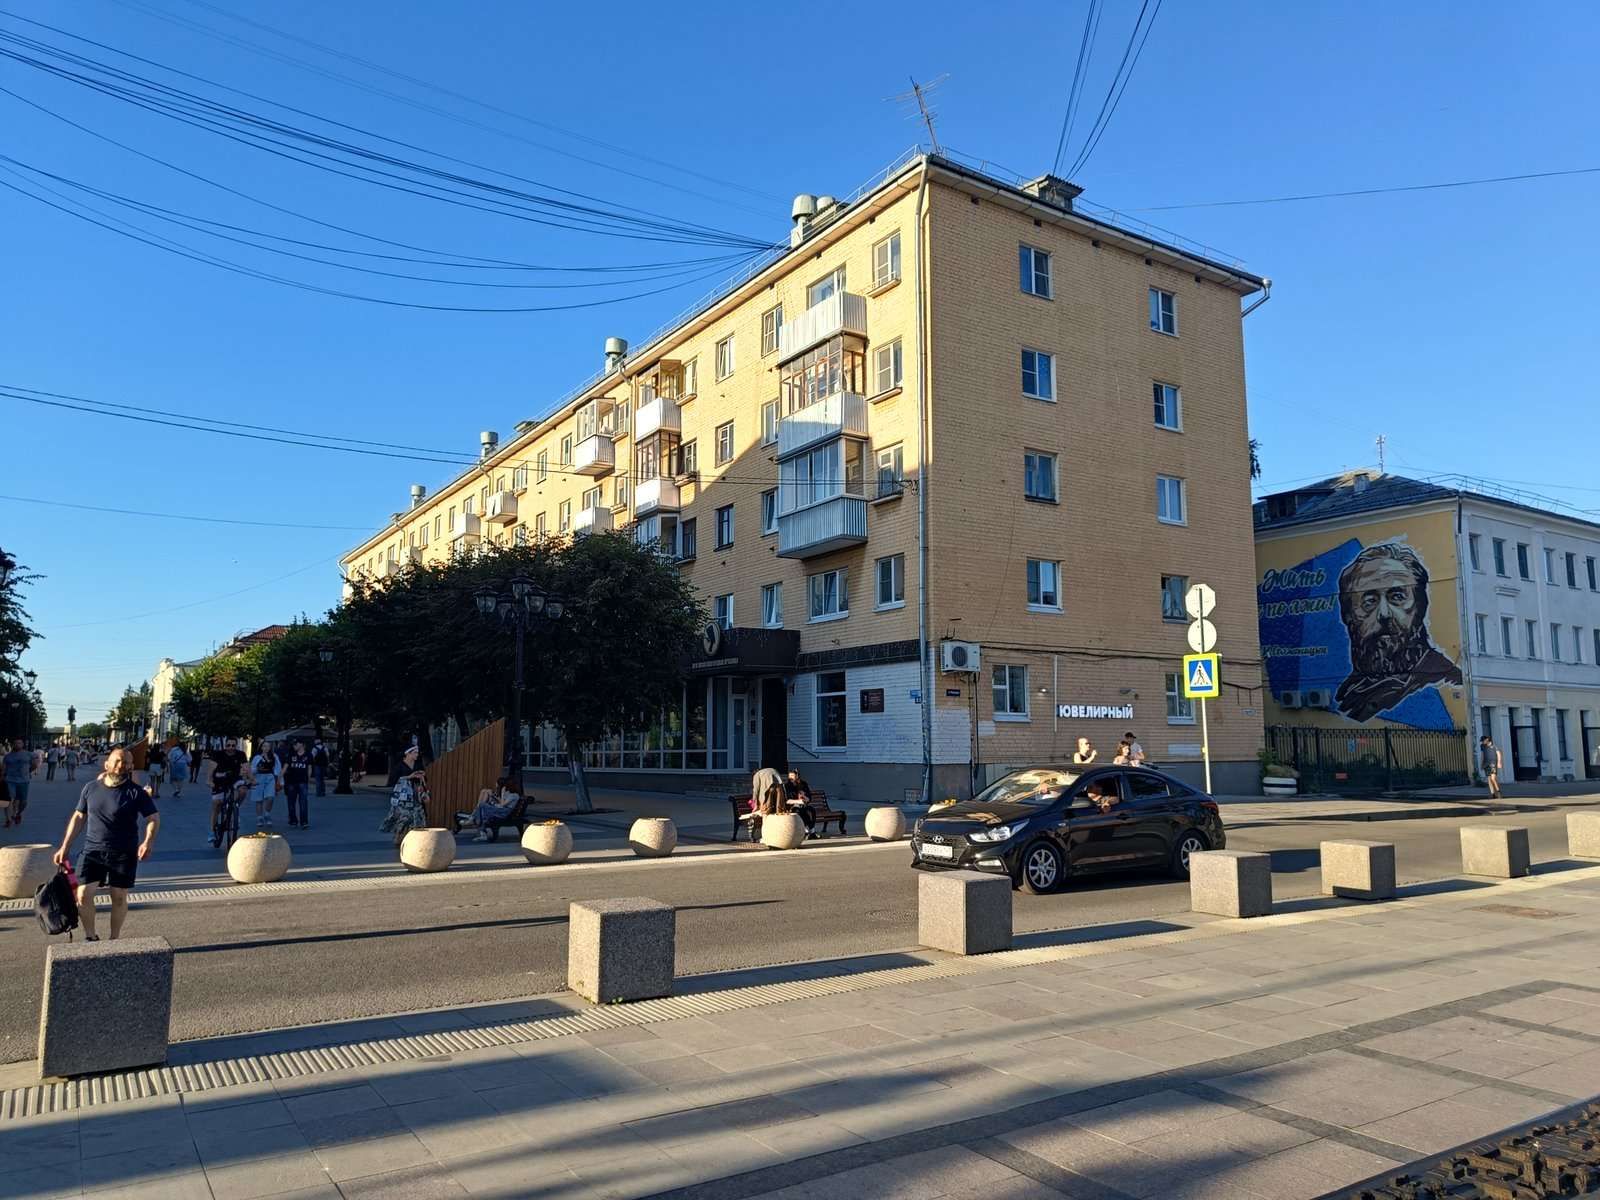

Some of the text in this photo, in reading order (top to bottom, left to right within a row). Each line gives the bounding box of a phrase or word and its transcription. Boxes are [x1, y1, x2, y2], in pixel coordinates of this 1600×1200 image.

[1262, 568, 1326, 592] Жить
[1265, 602, 1287, 617] по
[1059, 703, 1133, 719] ЮВЕЛИРНЫЙ
